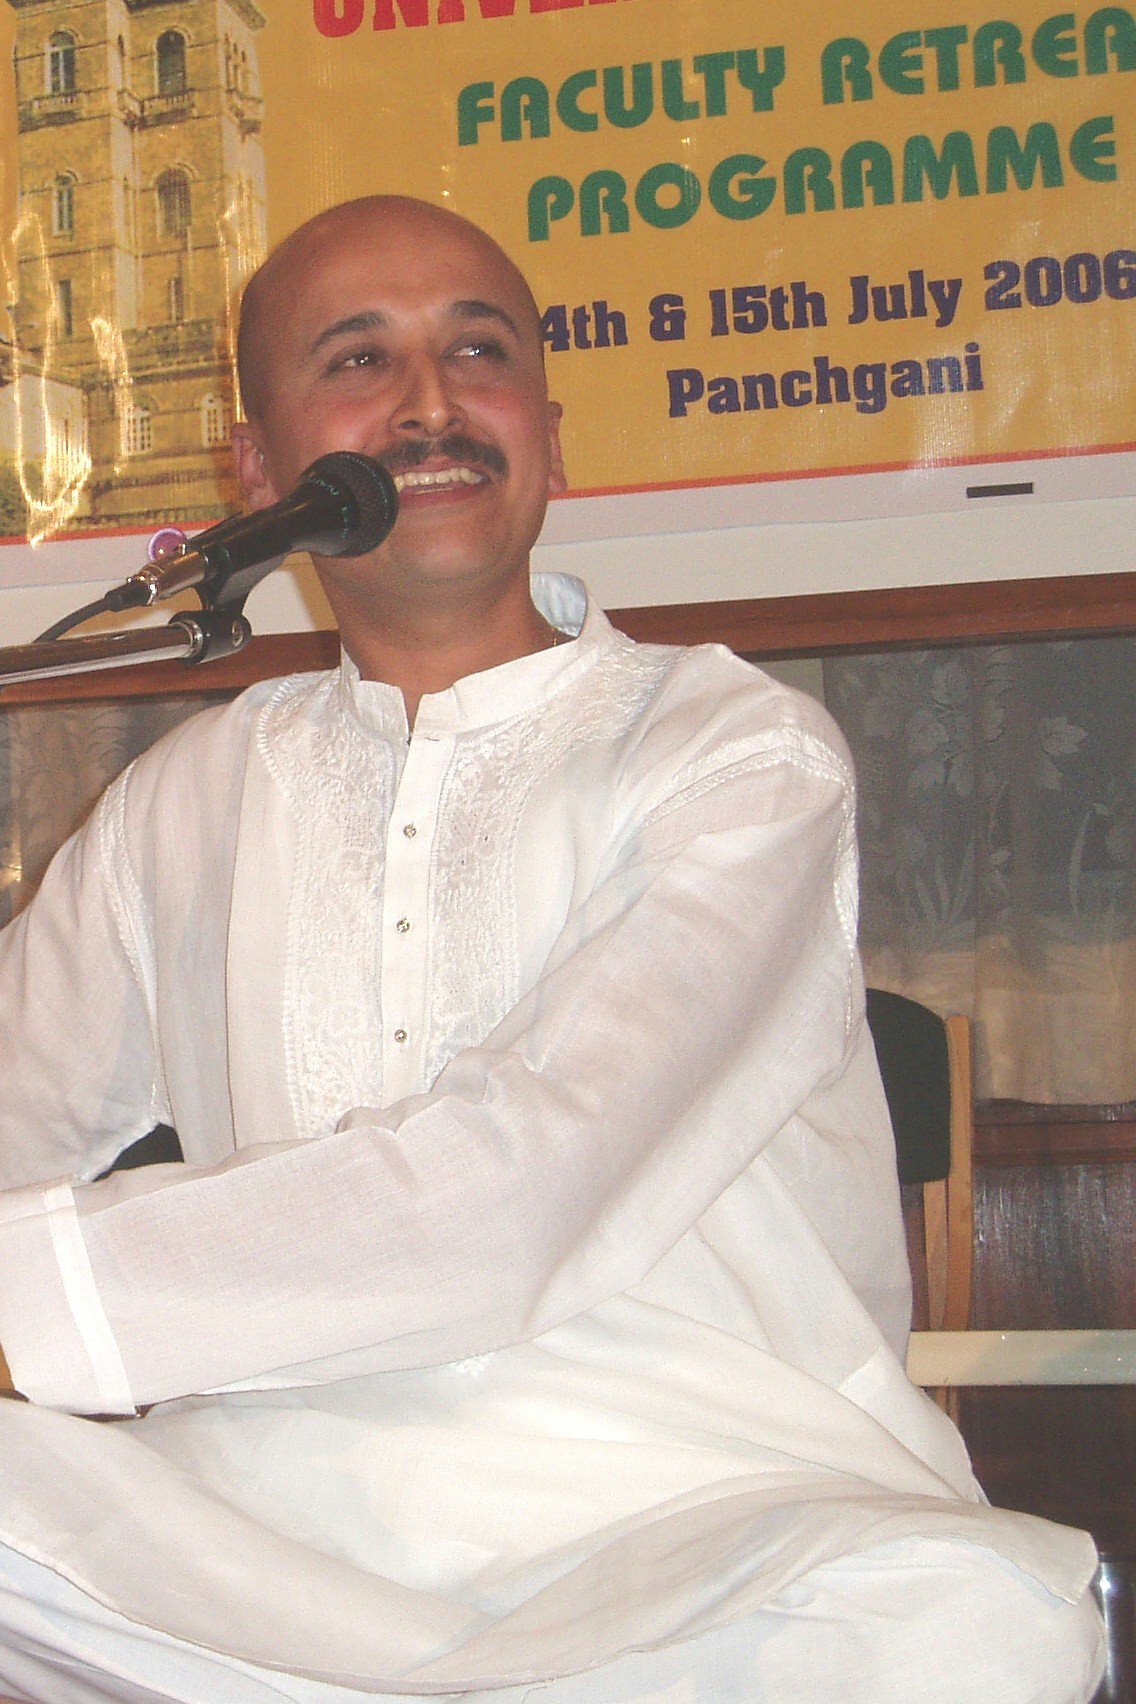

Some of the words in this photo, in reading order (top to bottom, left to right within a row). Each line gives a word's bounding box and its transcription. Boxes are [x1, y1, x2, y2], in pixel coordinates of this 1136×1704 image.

[458, 46, 786, 146] FACULTY
[527, 115, 1118, 242] PROGRAMME
[649, 293, 687, 341] &
[709, 281, 828, 337] 15th
[848, 271, 963, 328] July
[983, 249, 1136, 311] 2006
[666, 341, 984, 418] Panchgani
